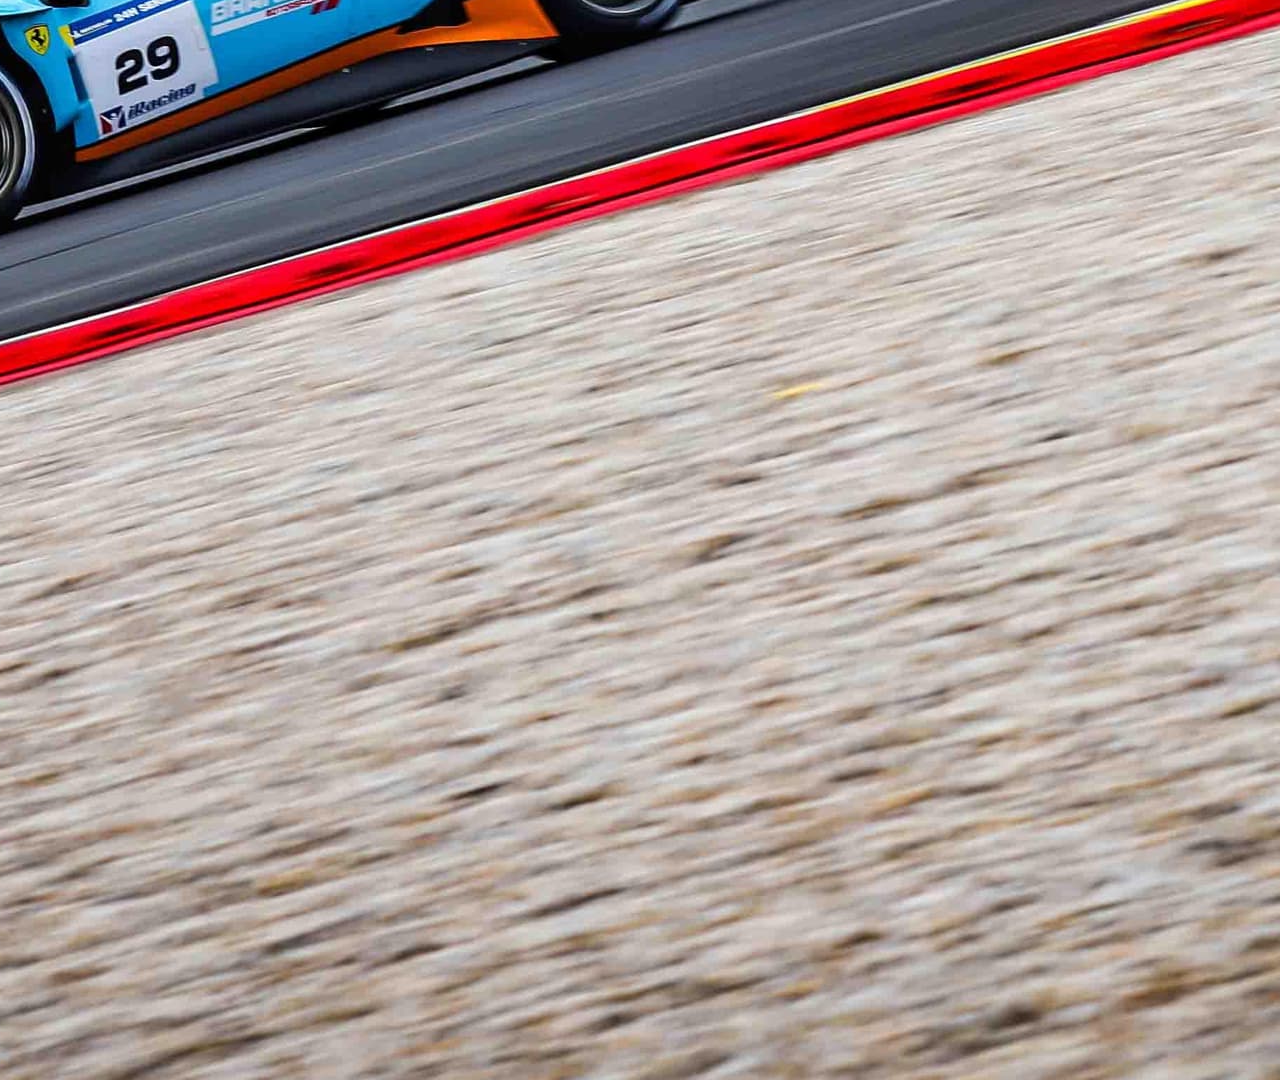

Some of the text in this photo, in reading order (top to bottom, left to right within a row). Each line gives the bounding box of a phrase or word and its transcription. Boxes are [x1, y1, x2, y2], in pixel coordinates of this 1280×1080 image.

[113, 6, 139, 22] 24H
[115, 35, 180, 95] 29
[127, 83, 196, 120] iRacing
